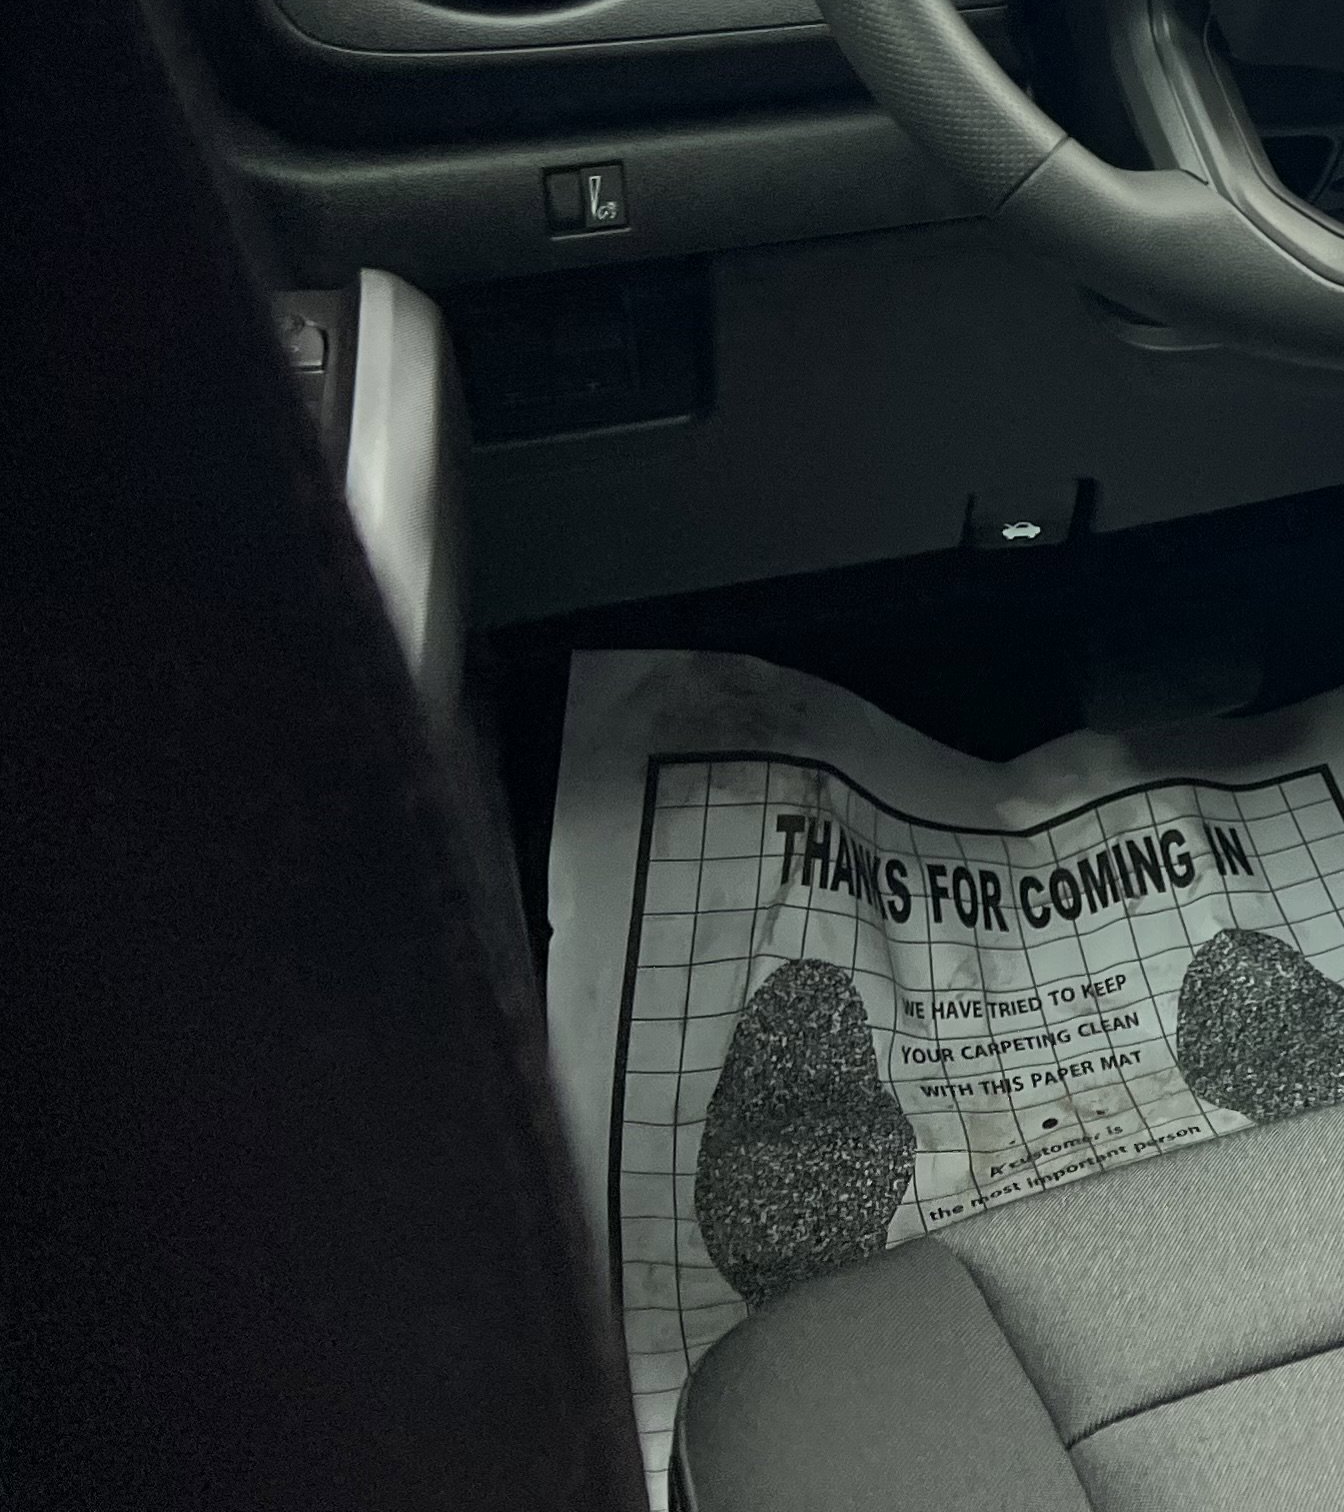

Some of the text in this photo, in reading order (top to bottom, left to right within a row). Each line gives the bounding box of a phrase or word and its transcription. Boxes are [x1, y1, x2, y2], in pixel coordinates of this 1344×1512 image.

[776, 813, 1255, 932] THANKS FOR COMING IN
[902, 974, 1127, 1020] WE HAVE TRIED TO KEEP
[901, 1012, 1140, 1065] YOUR CARPETING CLEAN
[920, 1050, 1142, 1098] WITH THIS PAPER MAT
[929, 1125, 1202, 1222] the most important person
[990, 1125, 1124, 1178] A customer is
